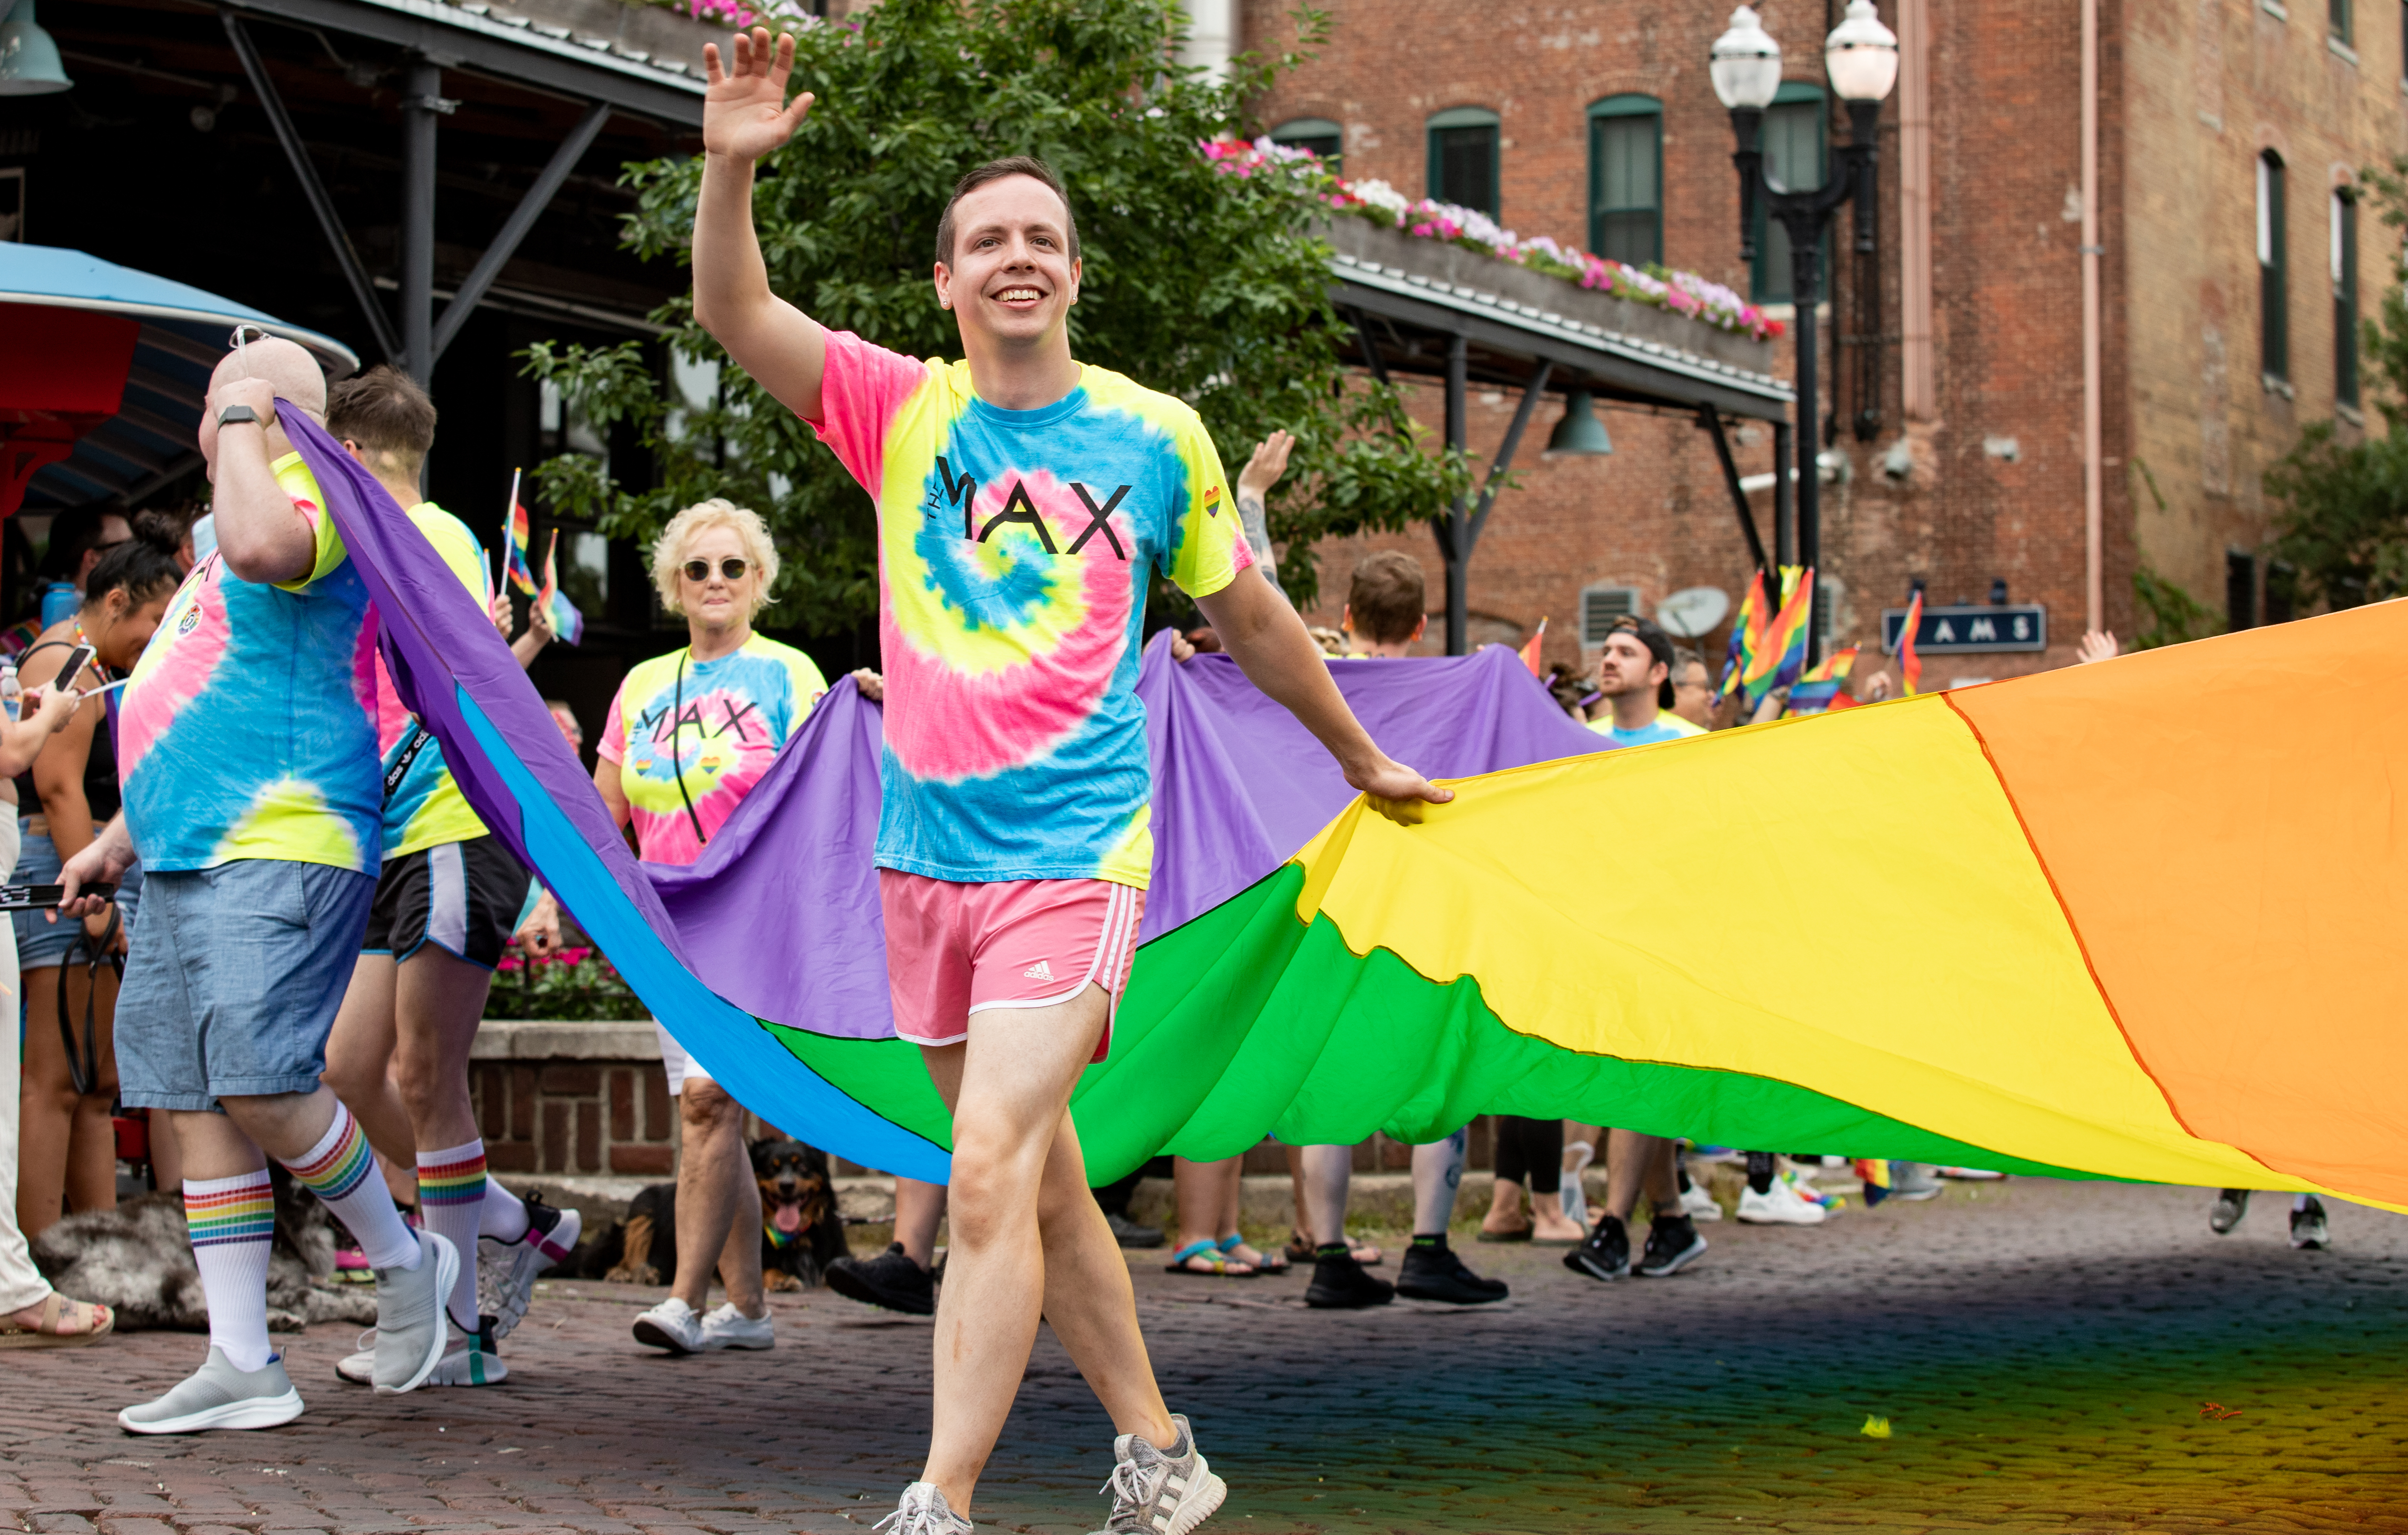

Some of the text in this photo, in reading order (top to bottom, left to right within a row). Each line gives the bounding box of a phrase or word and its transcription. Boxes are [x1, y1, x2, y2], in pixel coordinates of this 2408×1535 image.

[927, 456, 1132, 561] THE MAX
[1933, 615, 2030, 643] AMS
[641, 699, 758, 743] MAX
[388, 765, 404, 786] das
[1023, 971, 1054, 982] adidas
